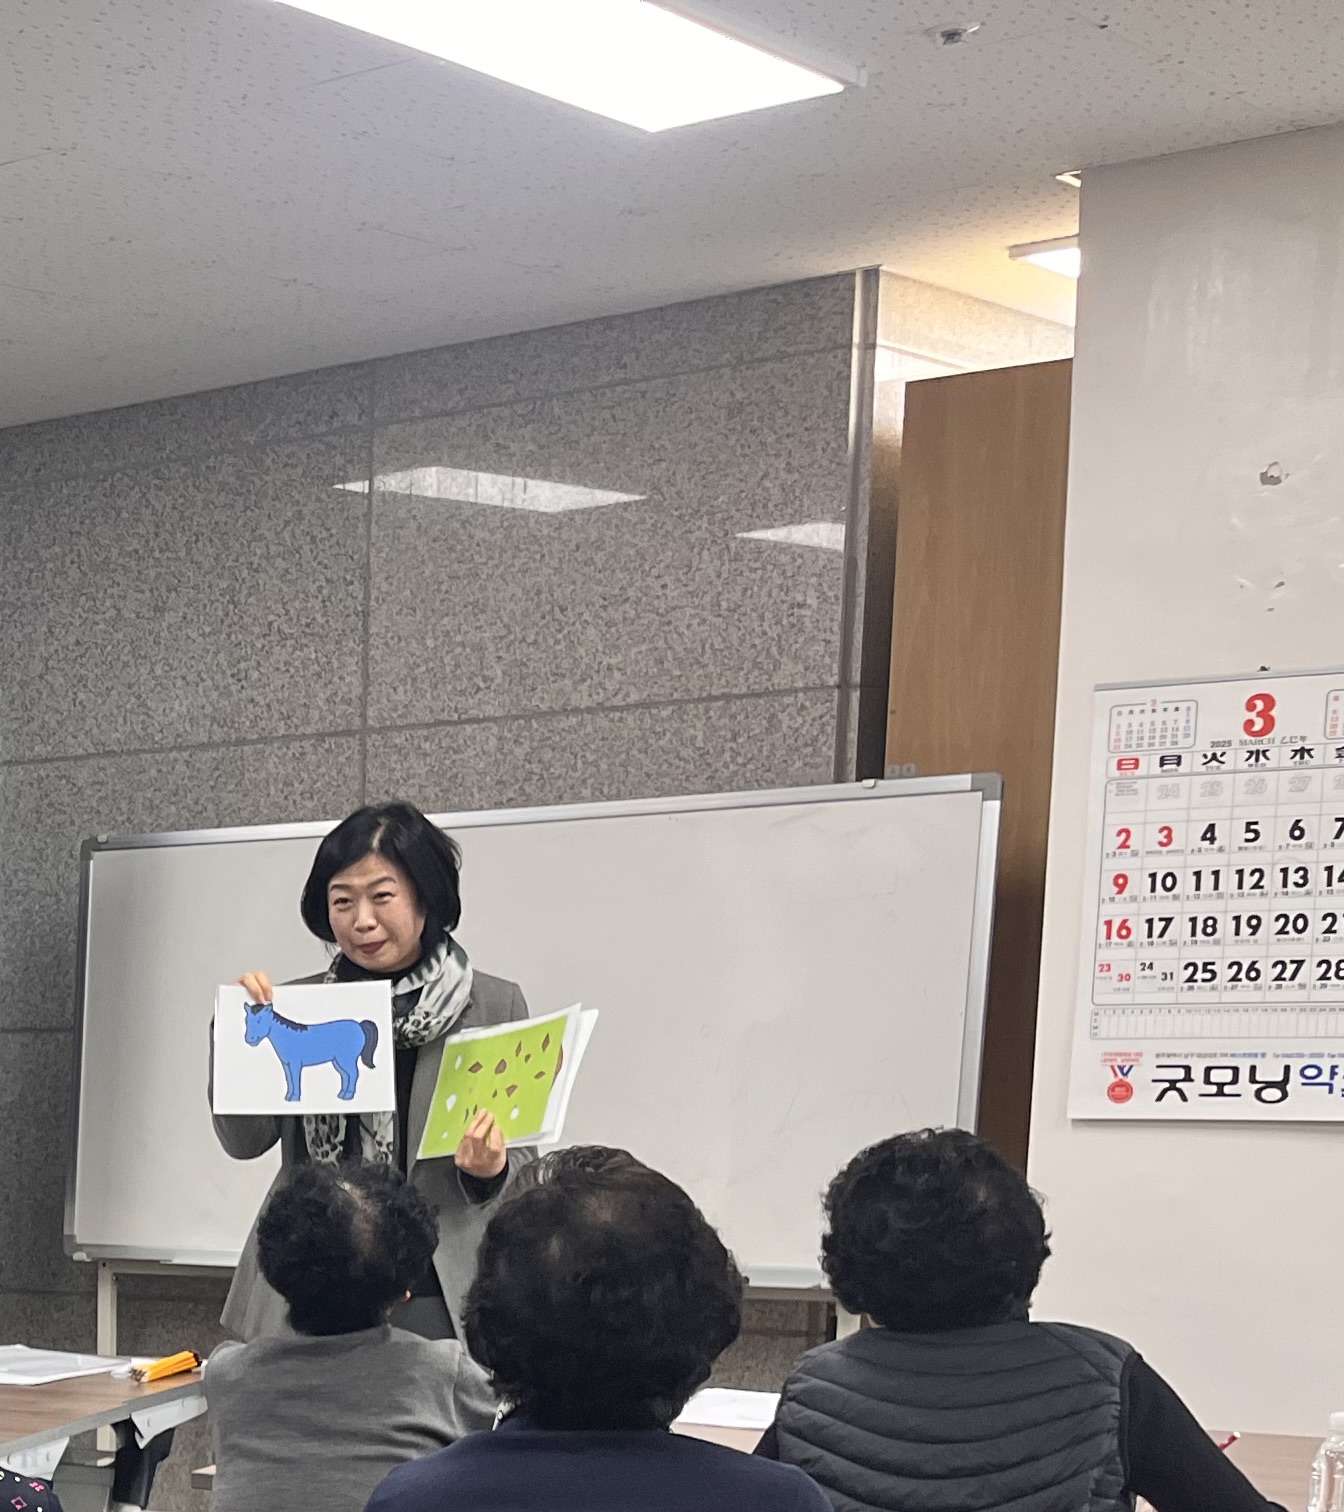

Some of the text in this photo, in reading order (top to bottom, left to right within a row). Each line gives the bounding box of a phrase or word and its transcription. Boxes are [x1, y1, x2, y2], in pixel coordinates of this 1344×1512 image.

[1243, 693, 1276, 737] 3
[1210, 736, 1276, 748] 2025 MARCH
[1116, 746, 1315, 771] 日 月 火 水 木
[1115, 828, 1132, 850] 2
[1157, 825, 1174, 848] 3
[1200, 823, 1217, 845] 4
[1244, 821, 1261, 843] 5
[1289, 819, 1306, 841] 6
[1112, 873, 1129, 895] 9
[1148, 871, 1178, 893] 10
[1192, 869, 1221, 892] 11
[1235, 867, 1265, 890] 12
[1279, 866, 1310, 888] 13
[1103, 912, 1344, 941] 16 17 18 19 20 2
[1098, 962, 1154, 973] 23 24
[1116, 973, 1131, 983] 30
[1160, 971, 1174, 981] 31
[1183, 961, 1218, 984] 25
[1226, 960, 1262, 983] 26
[1271, 959, 1307, 982] 27
